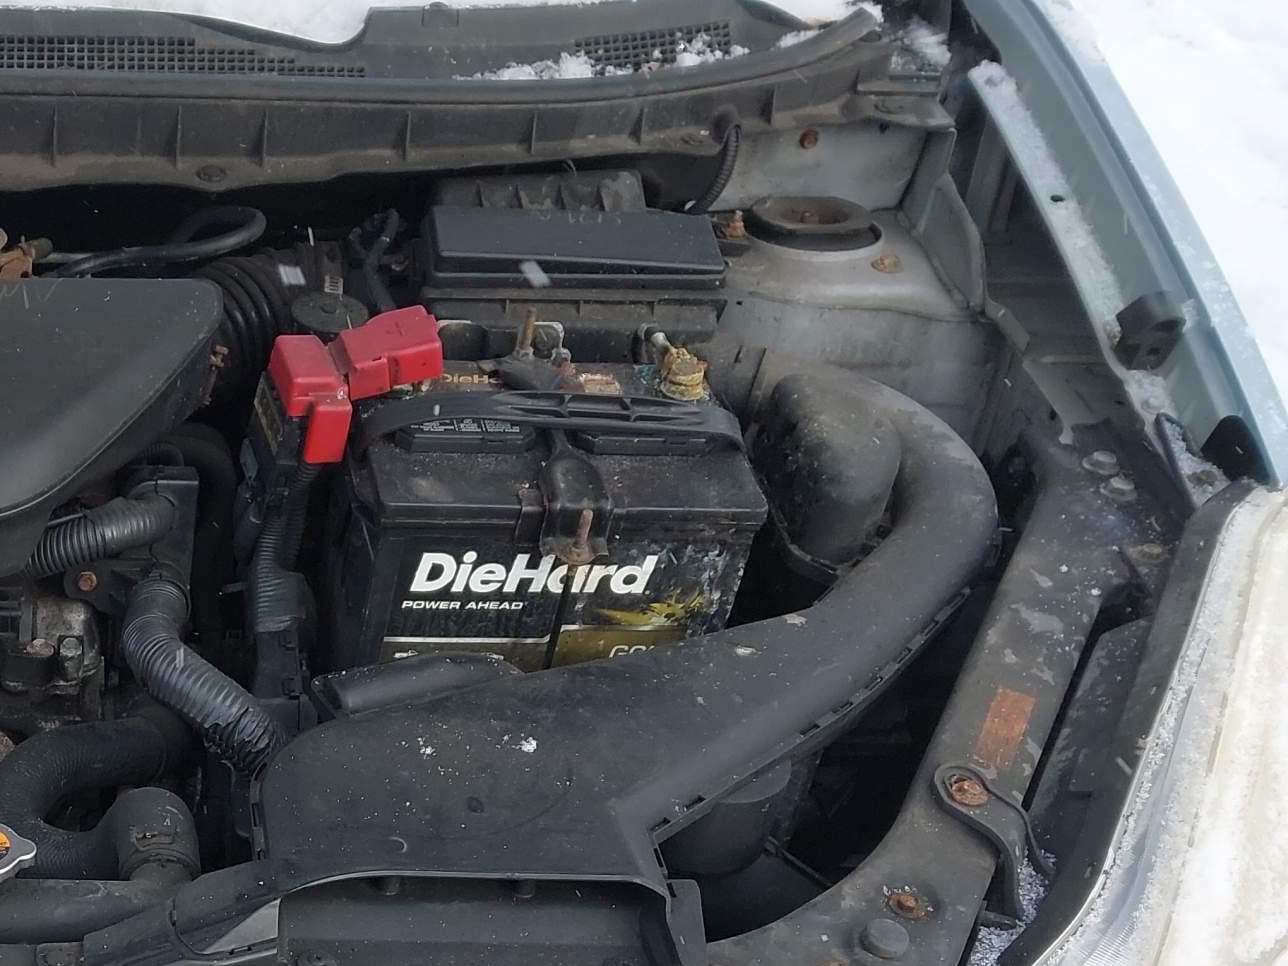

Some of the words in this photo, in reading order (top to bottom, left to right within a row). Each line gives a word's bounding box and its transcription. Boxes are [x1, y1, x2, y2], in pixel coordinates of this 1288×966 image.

[409, 550, 659, 594] DieHard
[401, 600, 460, 610] POWER
[465, 600, 524, 610] AHEAD
